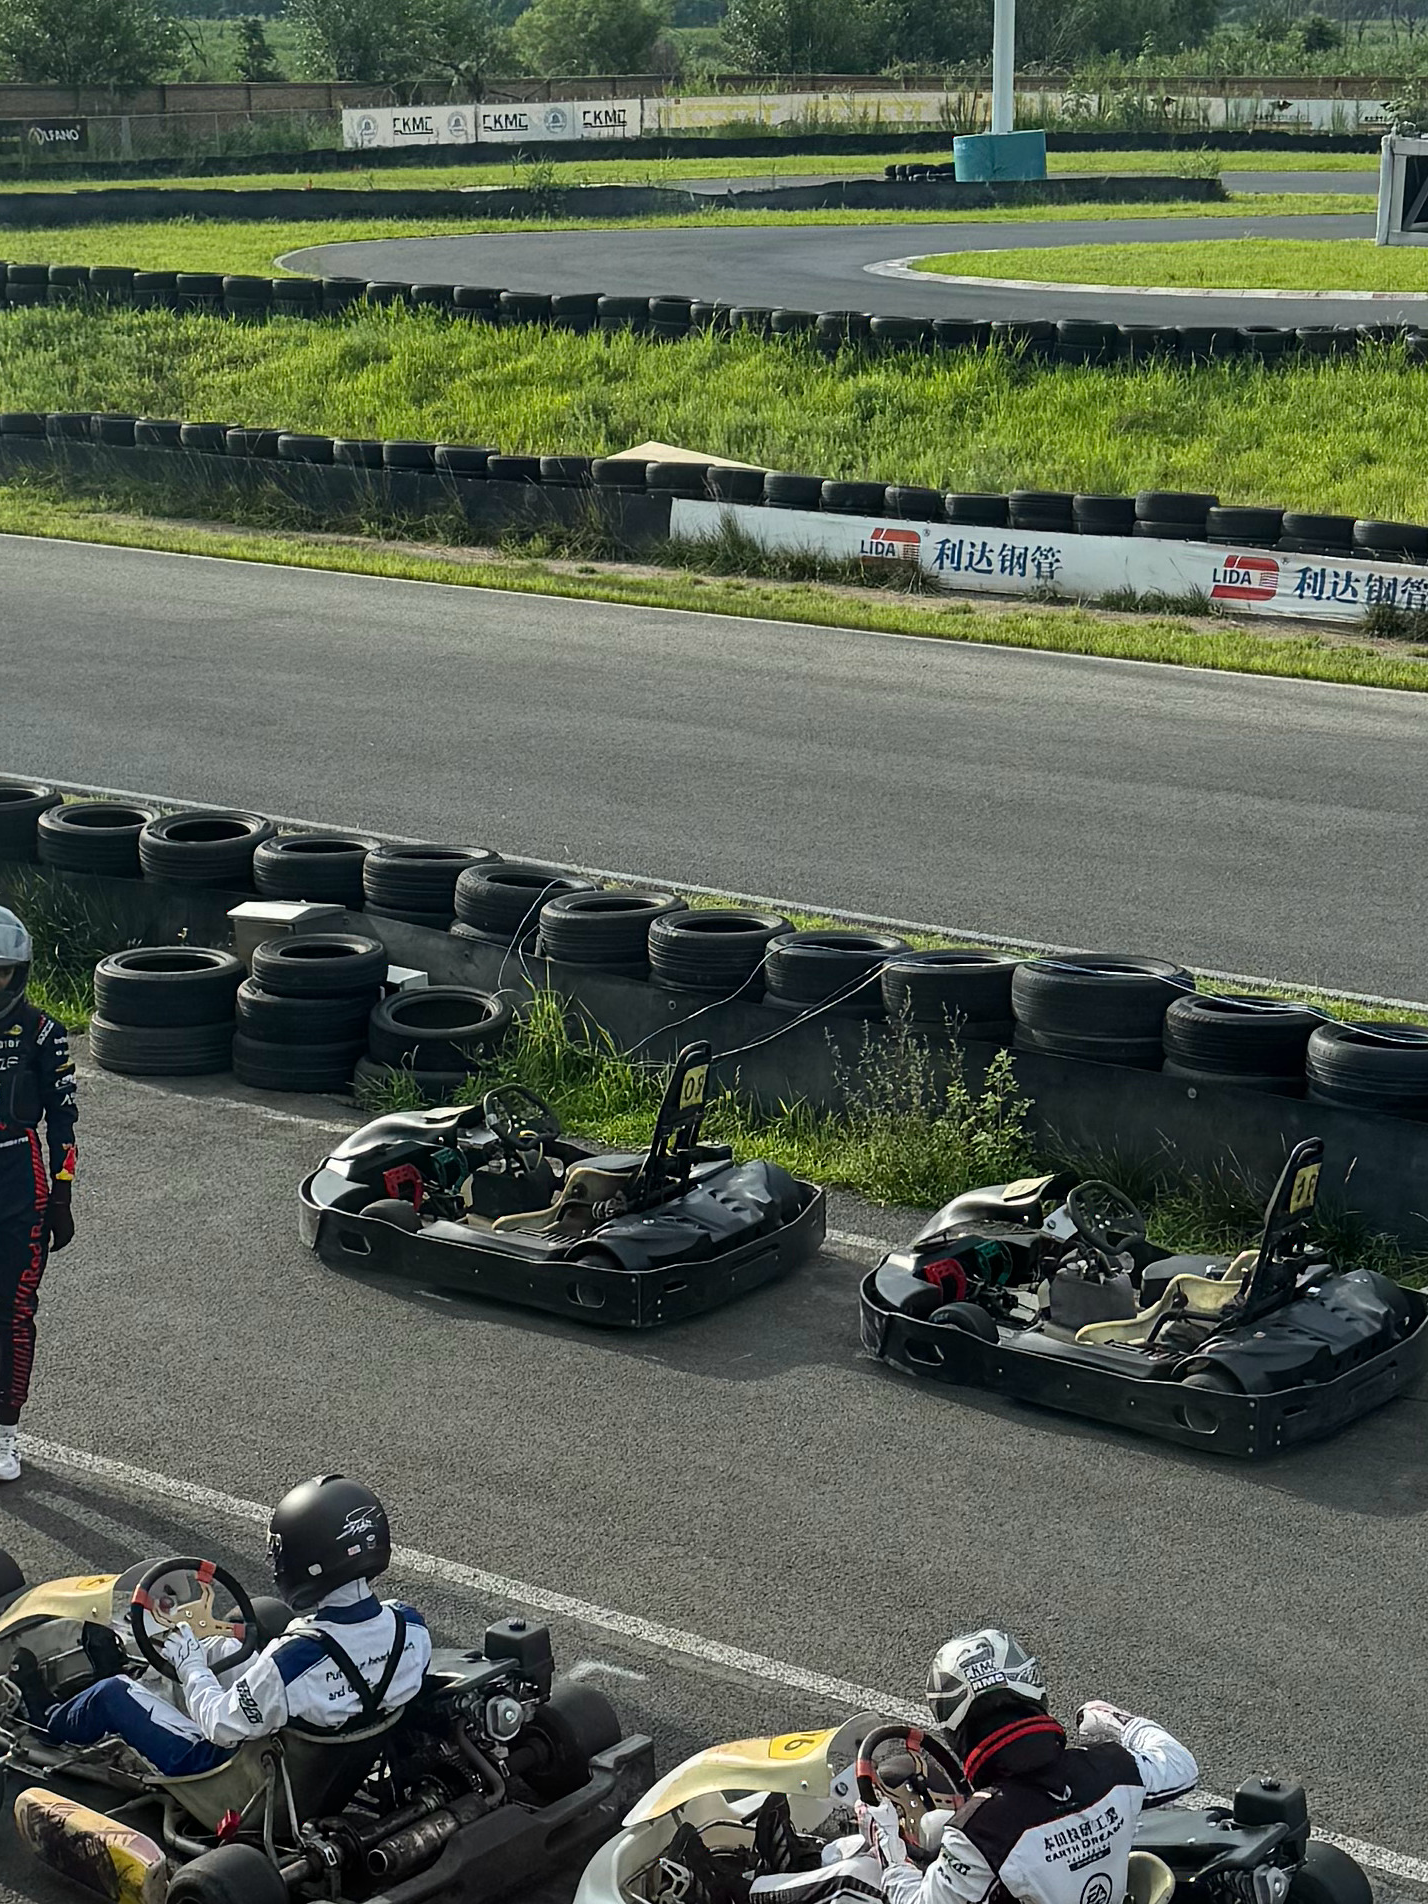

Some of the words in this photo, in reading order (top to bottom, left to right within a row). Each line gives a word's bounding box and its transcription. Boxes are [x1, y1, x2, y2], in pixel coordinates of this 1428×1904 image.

[860, 539, 896, 557] LIDA
[931, 537, 1064, 581] 利达钢管
[1212, 567, 1252, 586] LIDA
